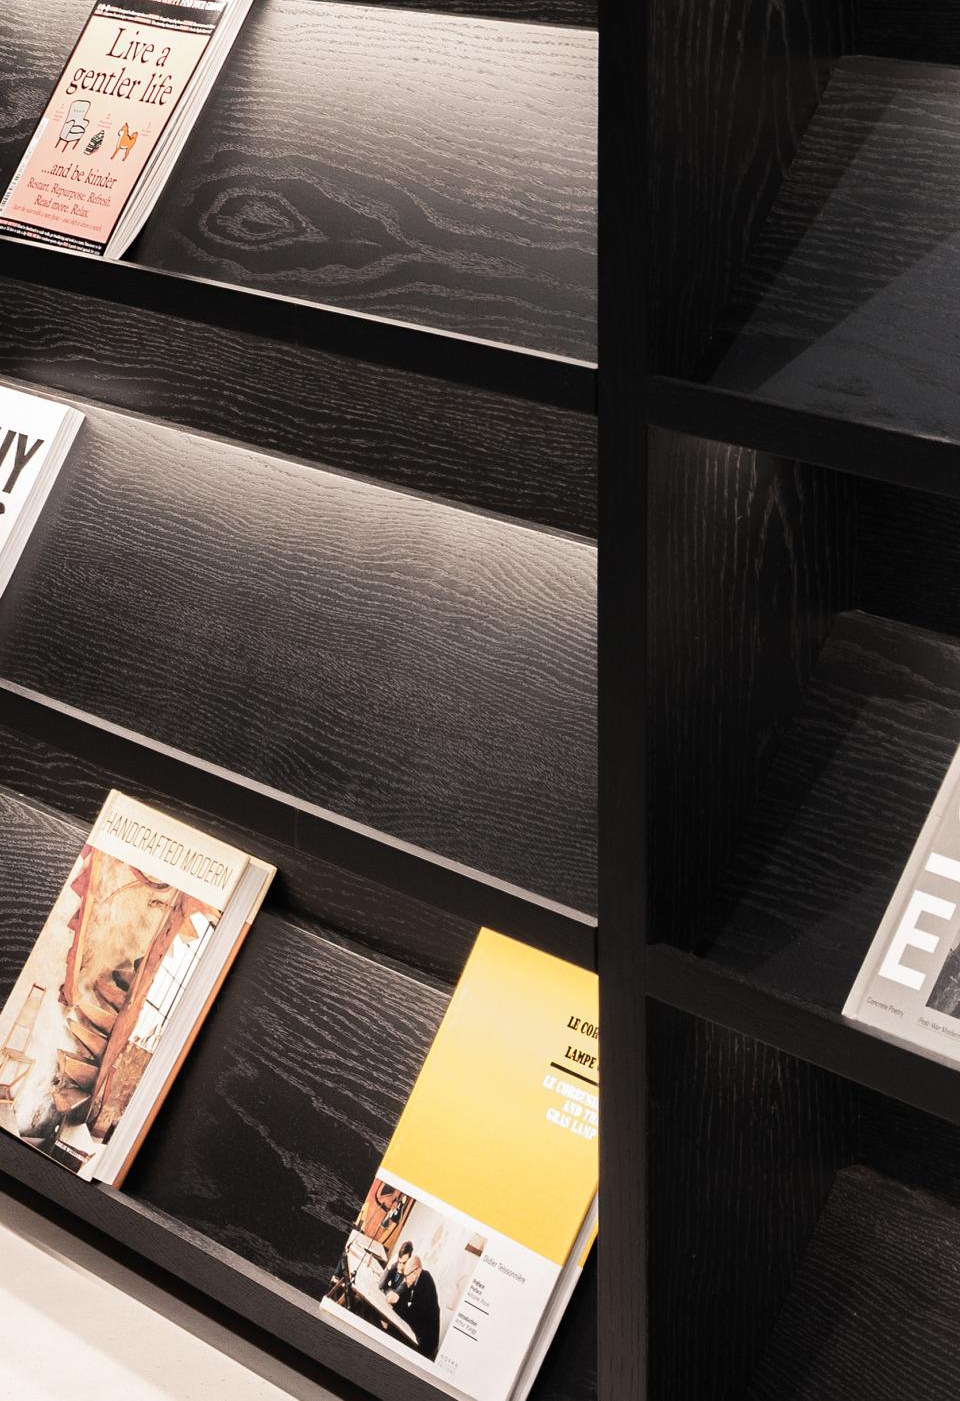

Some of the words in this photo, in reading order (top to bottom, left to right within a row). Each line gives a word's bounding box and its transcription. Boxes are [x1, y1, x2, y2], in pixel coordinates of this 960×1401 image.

[105, 27, 155, 64] Live
[155, 46, 171, 67] a
[66, 67, 142, 99] gentler
[138, 73, 173, 106] life
[70, 163, 85, 182] be
[84, 168, 118, 189] kinder
[33, 194, 54, 209] Read
[50, 182, 87, 201] Repurpose.
[102, 812, 185, 866] HANDCRAFTED
[181, 848, 234, 890] MODERN
[566, 1015, 581, 1031] LE
[564, 1045, 597, 1070] LAMPE
[543, 1075, 557, 1090] LE
